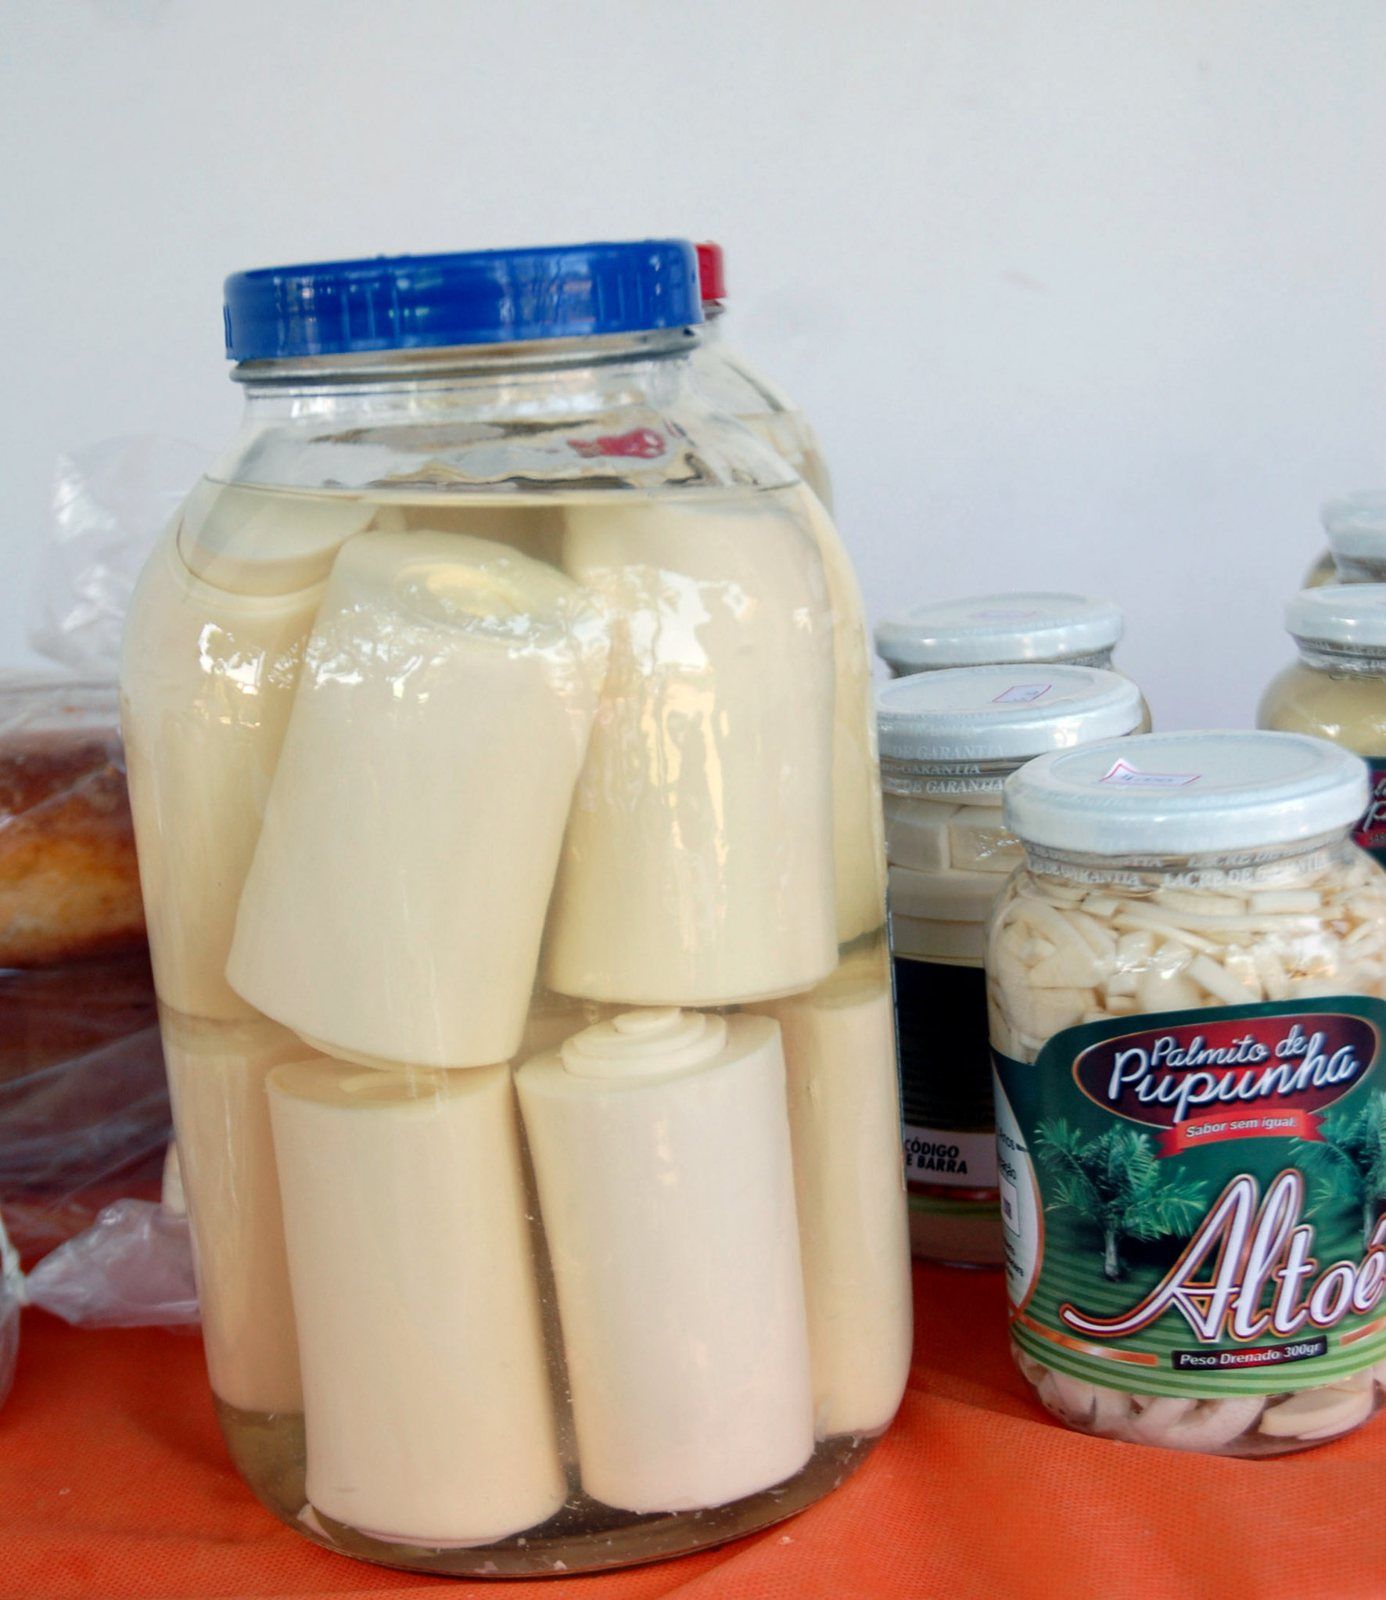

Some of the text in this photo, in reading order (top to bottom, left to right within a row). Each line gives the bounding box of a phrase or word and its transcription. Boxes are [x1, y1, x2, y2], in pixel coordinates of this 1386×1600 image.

[926, 778, 1004, 794] GARANTIA
[1151, 1024, 1307, 1067] Palmito de
[1108, 1031, 1360, 1123] Pupunha
[1186, 1122, 1226, 1138] Sabor
[1230, 1118, 1258, 1130] sem
[904, 1136, 960, 1159] CÓDIGO
[916, 1155, 968, 1175] BARRA
[1180, 1343, 1322, 1366] Peso Drenado 300gr
